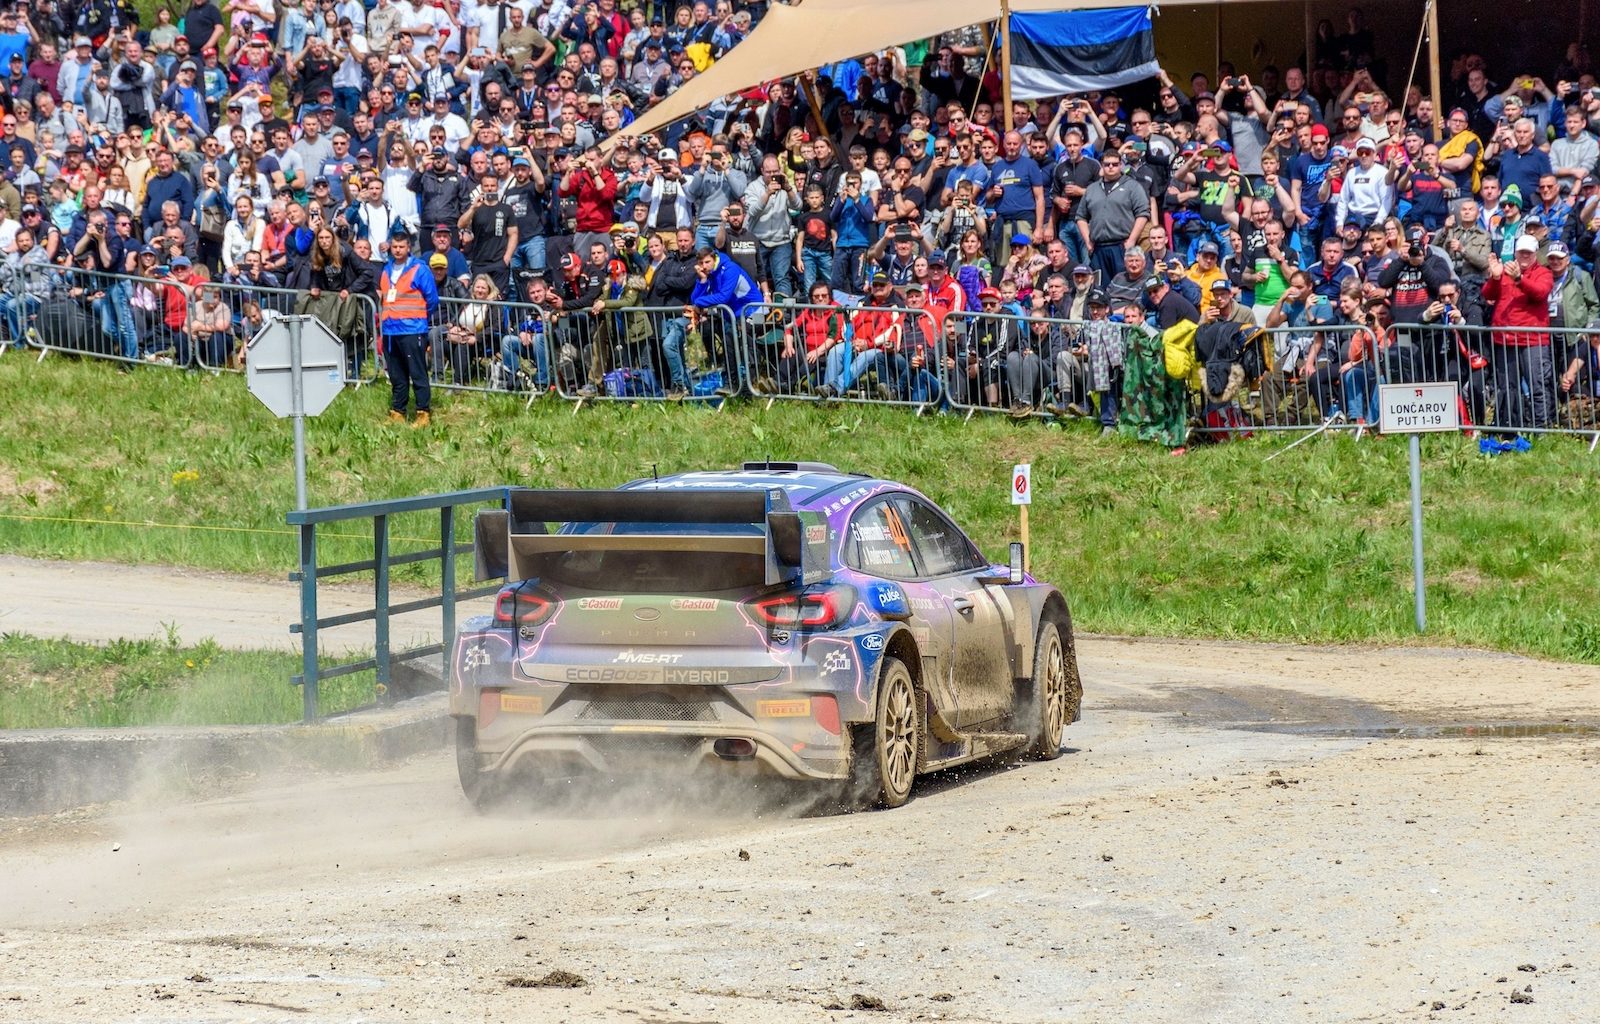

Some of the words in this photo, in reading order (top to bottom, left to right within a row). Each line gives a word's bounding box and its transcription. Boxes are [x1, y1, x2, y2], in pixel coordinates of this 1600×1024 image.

[1390, 402, 1447, 415] LONČAROV
[1397, 416, 1418, 426] PUT
[1422, 415, 1442, 425] 1-19
[588, 598, 620, 609] Castrol
[681, 599, 716, 610] Castrol
[625, 653, 683, 664] MS-RT
[665, 670, 729, 683] HYBRID
